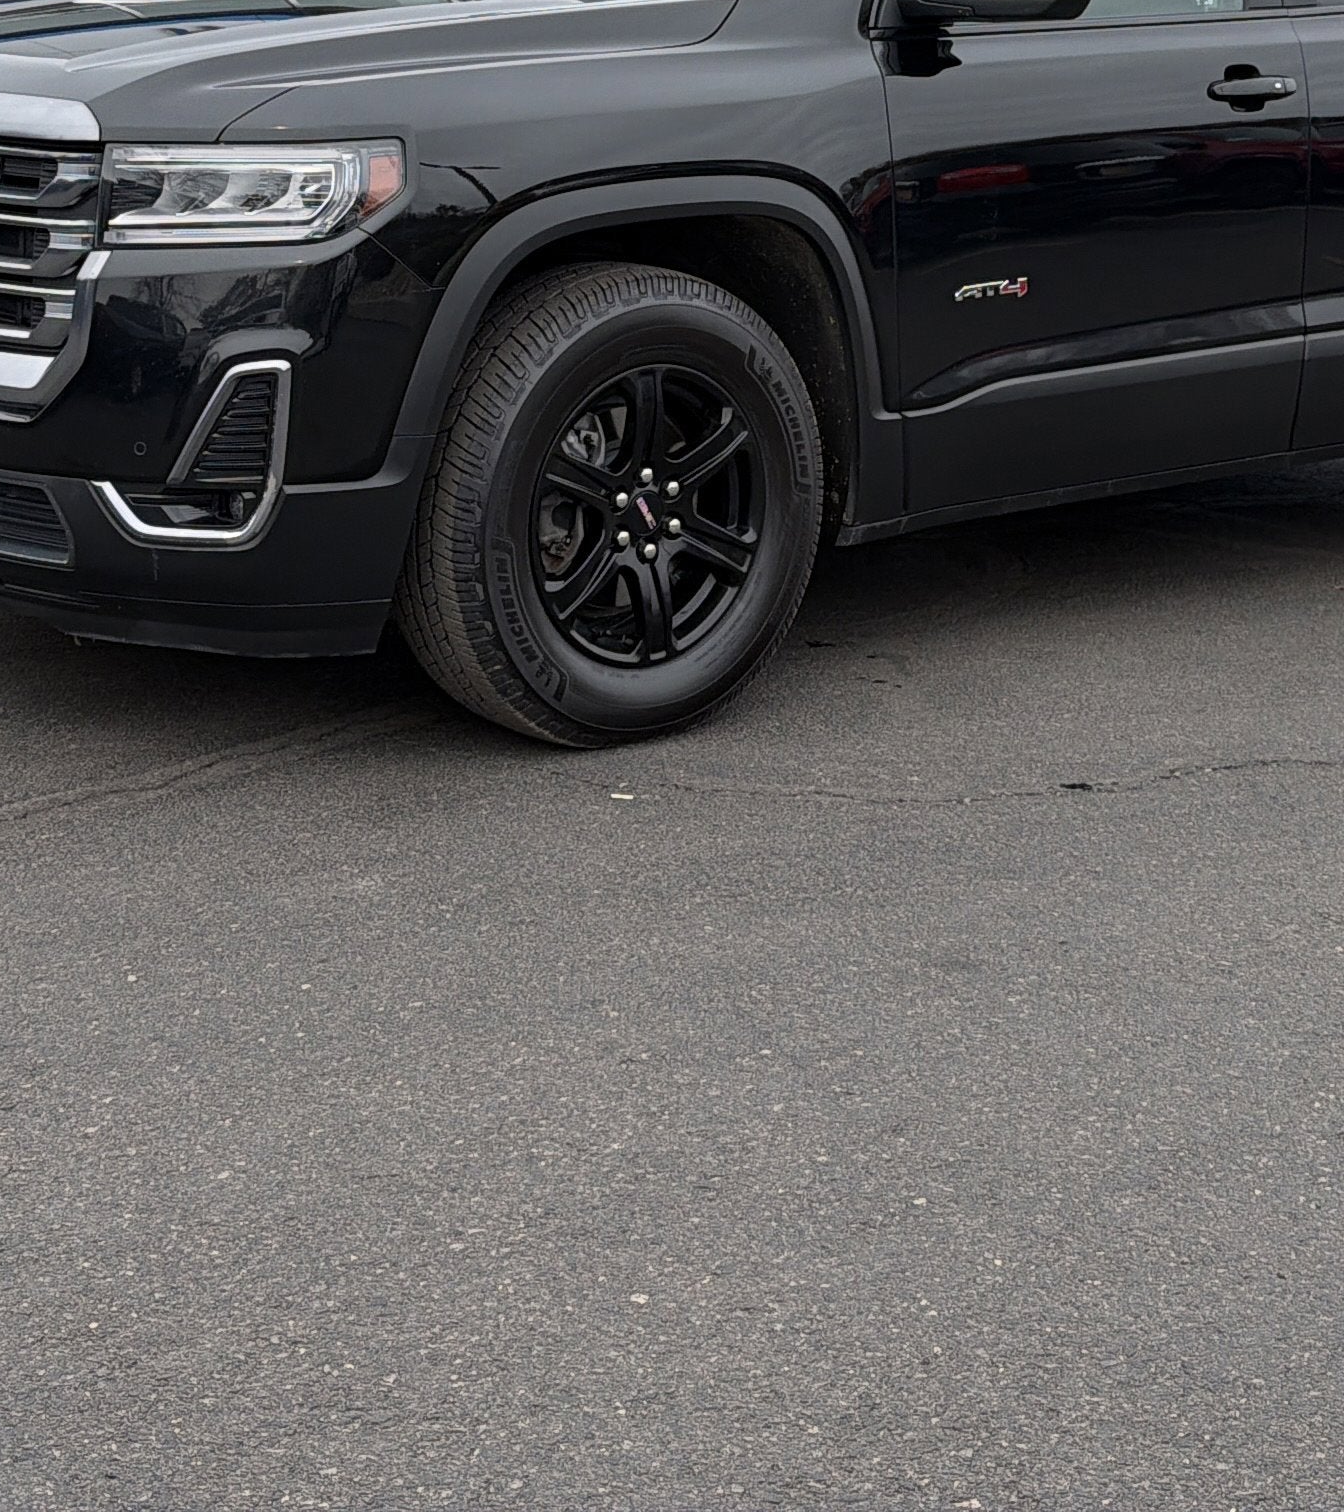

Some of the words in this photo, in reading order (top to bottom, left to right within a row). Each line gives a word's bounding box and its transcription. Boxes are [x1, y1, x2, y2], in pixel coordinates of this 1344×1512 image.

[954, 276, 1028, 302] AT4
[771, 379, 812, 479] MICHELIN
[495, 556, 540, 664] MICHELIN
